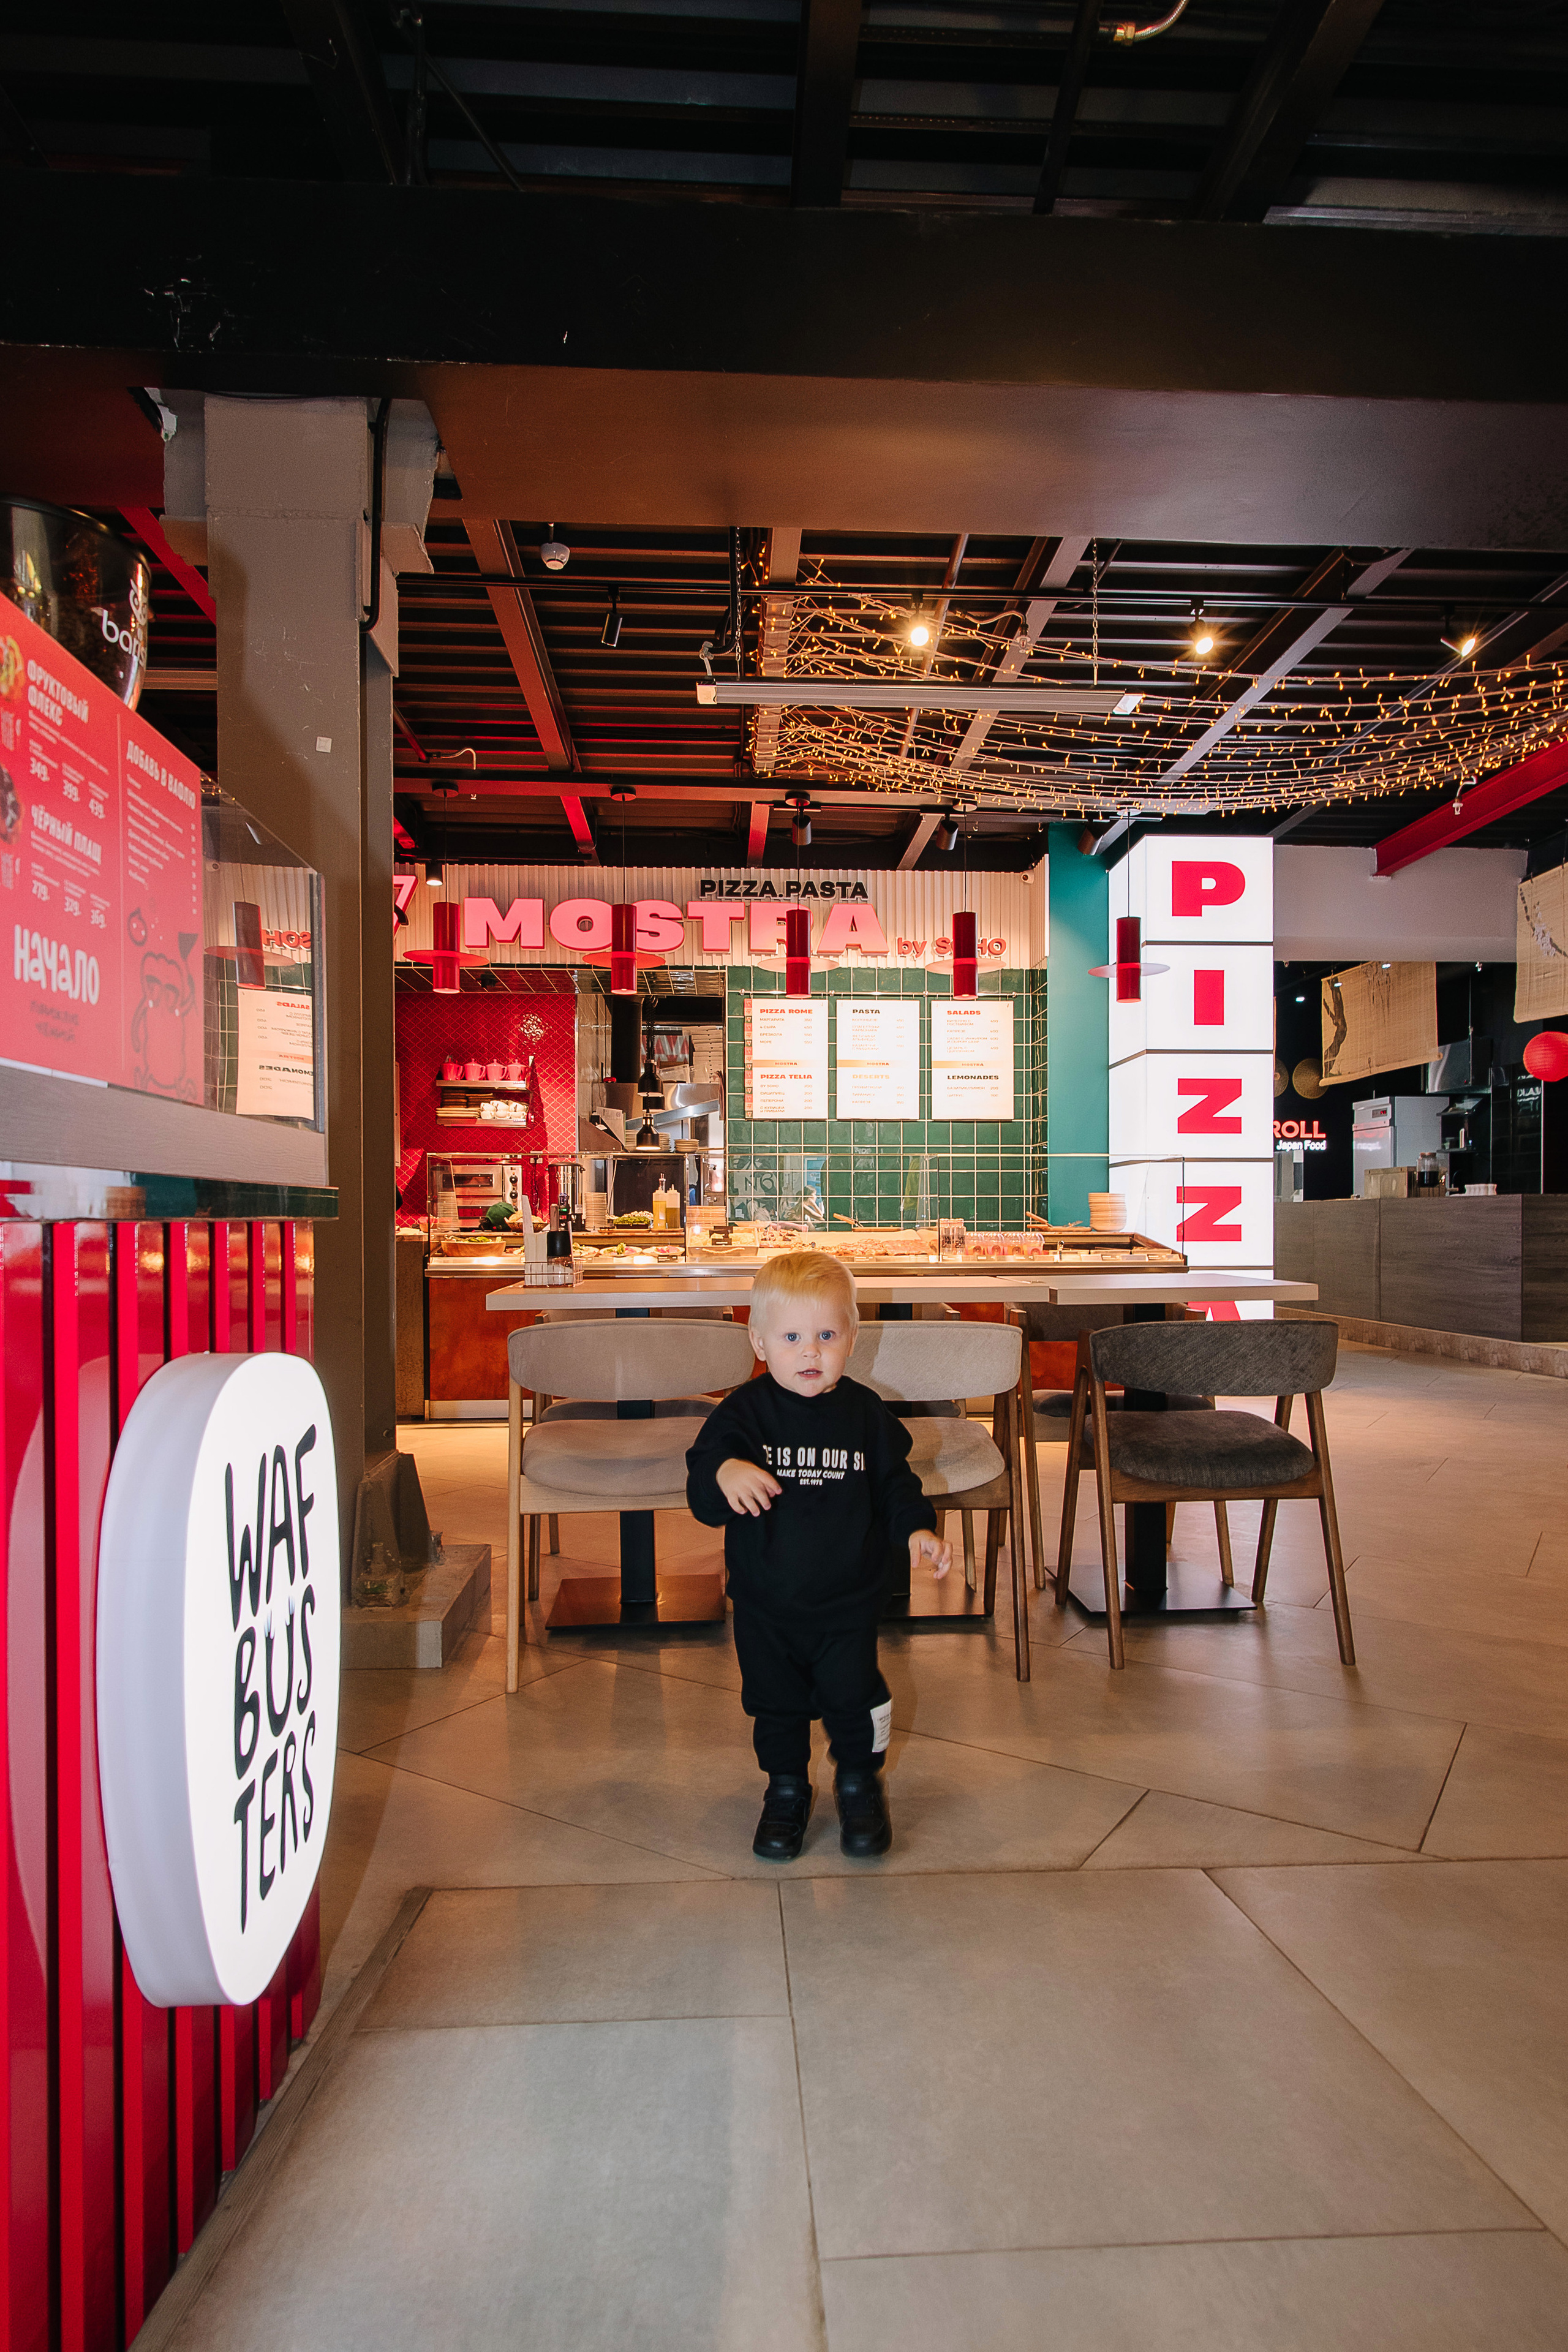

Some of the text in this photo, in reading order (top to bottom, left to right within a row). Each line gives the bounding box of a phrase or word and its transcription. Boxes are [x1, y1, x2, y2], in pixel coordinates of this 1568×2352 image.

[28, 660, 89, 724] ФРУКТОВЫЙ
[28, 685, 63, 726] ФЛЕКС
[126, 740, 160, 782] ДОБАВЬ
[160, 767, 167, 787] В
[168, 773, 196, 810] ВАФЛЮ
[74, 831, 102, 865] ПЛАЩ
[464, 897, 890, 954] MOSTRA
[897, 937, 1006, 957] by SHO
[1276, 1140, 1327, 1152] Japan Food
[776, 1469, 845, 1480] MAKE TODAY COUNT
[777, 1447, 791, 1466] IS
[797, 1446, 816, 1467] ON
[822, 1447, 848, 1469] OUR
[224, 1423, 317, 1633] WAF
[234, 1709, 316, 1936] TERS
